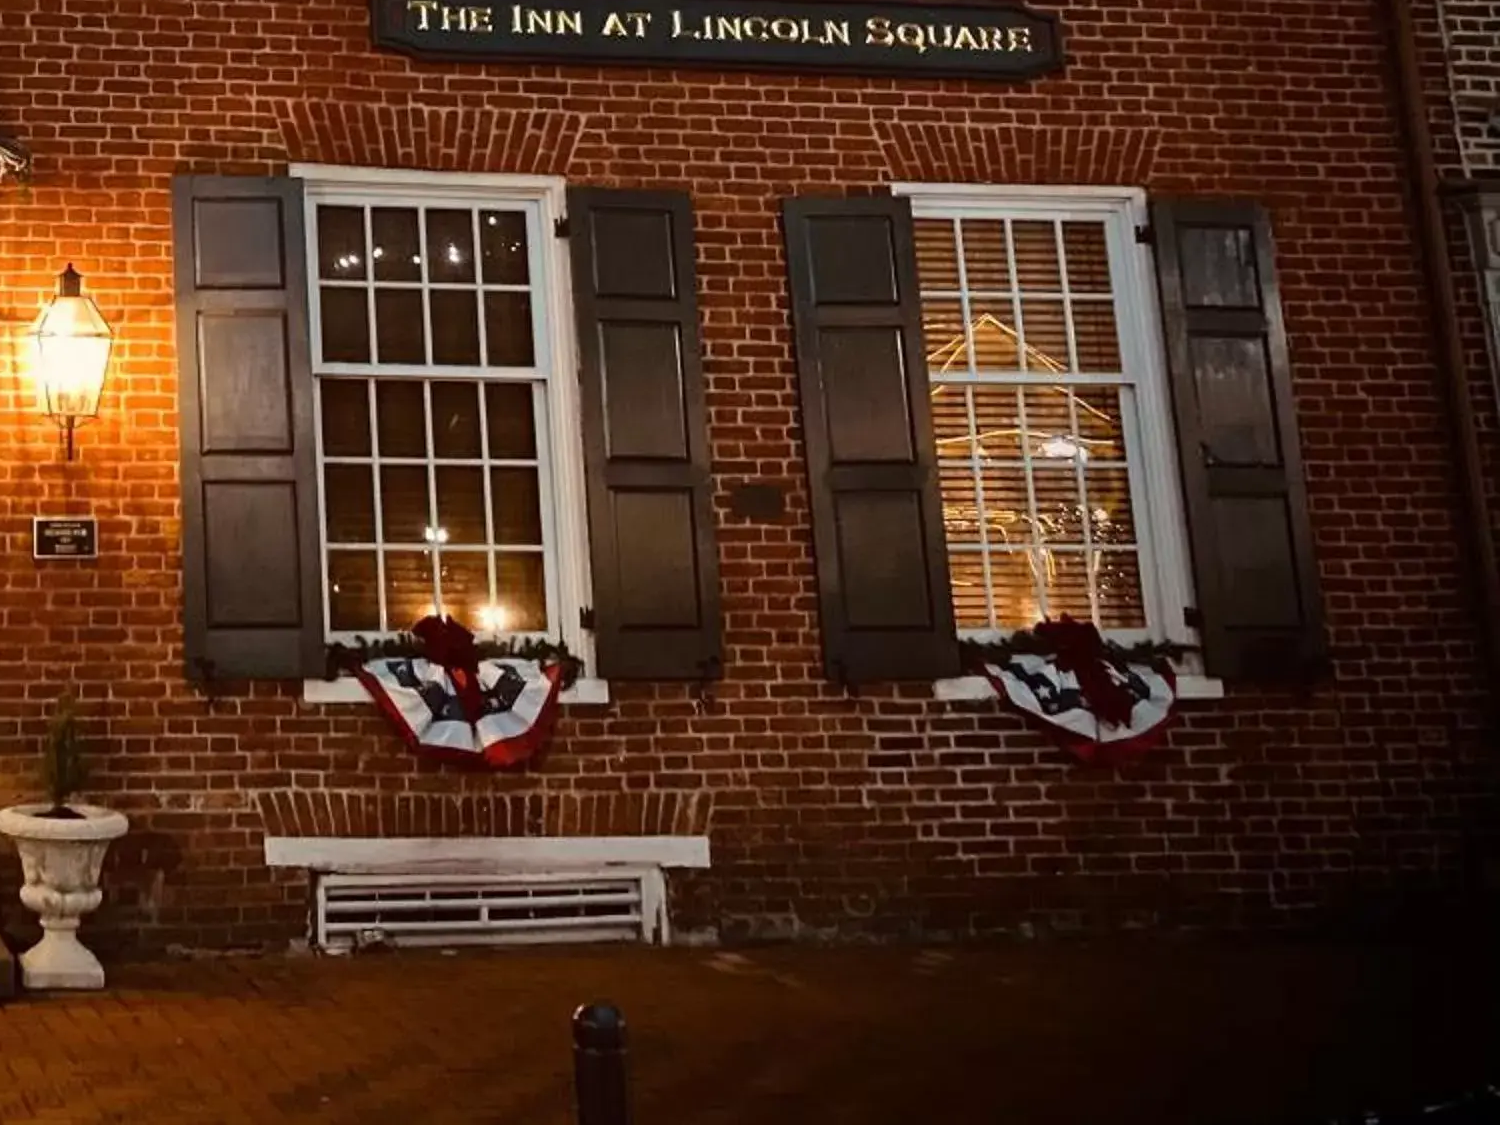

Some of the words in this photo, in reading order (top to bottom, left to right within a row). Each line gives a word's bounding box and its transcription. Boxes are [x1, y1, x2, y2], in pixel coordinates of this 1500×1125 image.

[407, 0, 492, 32] THE
[511, 5, 583, 35] INN
[602, 12, 651, 38] AT
[671, 10, 850, 45] LINCOLN
[866, 18, 1032, 53] SQUARE
